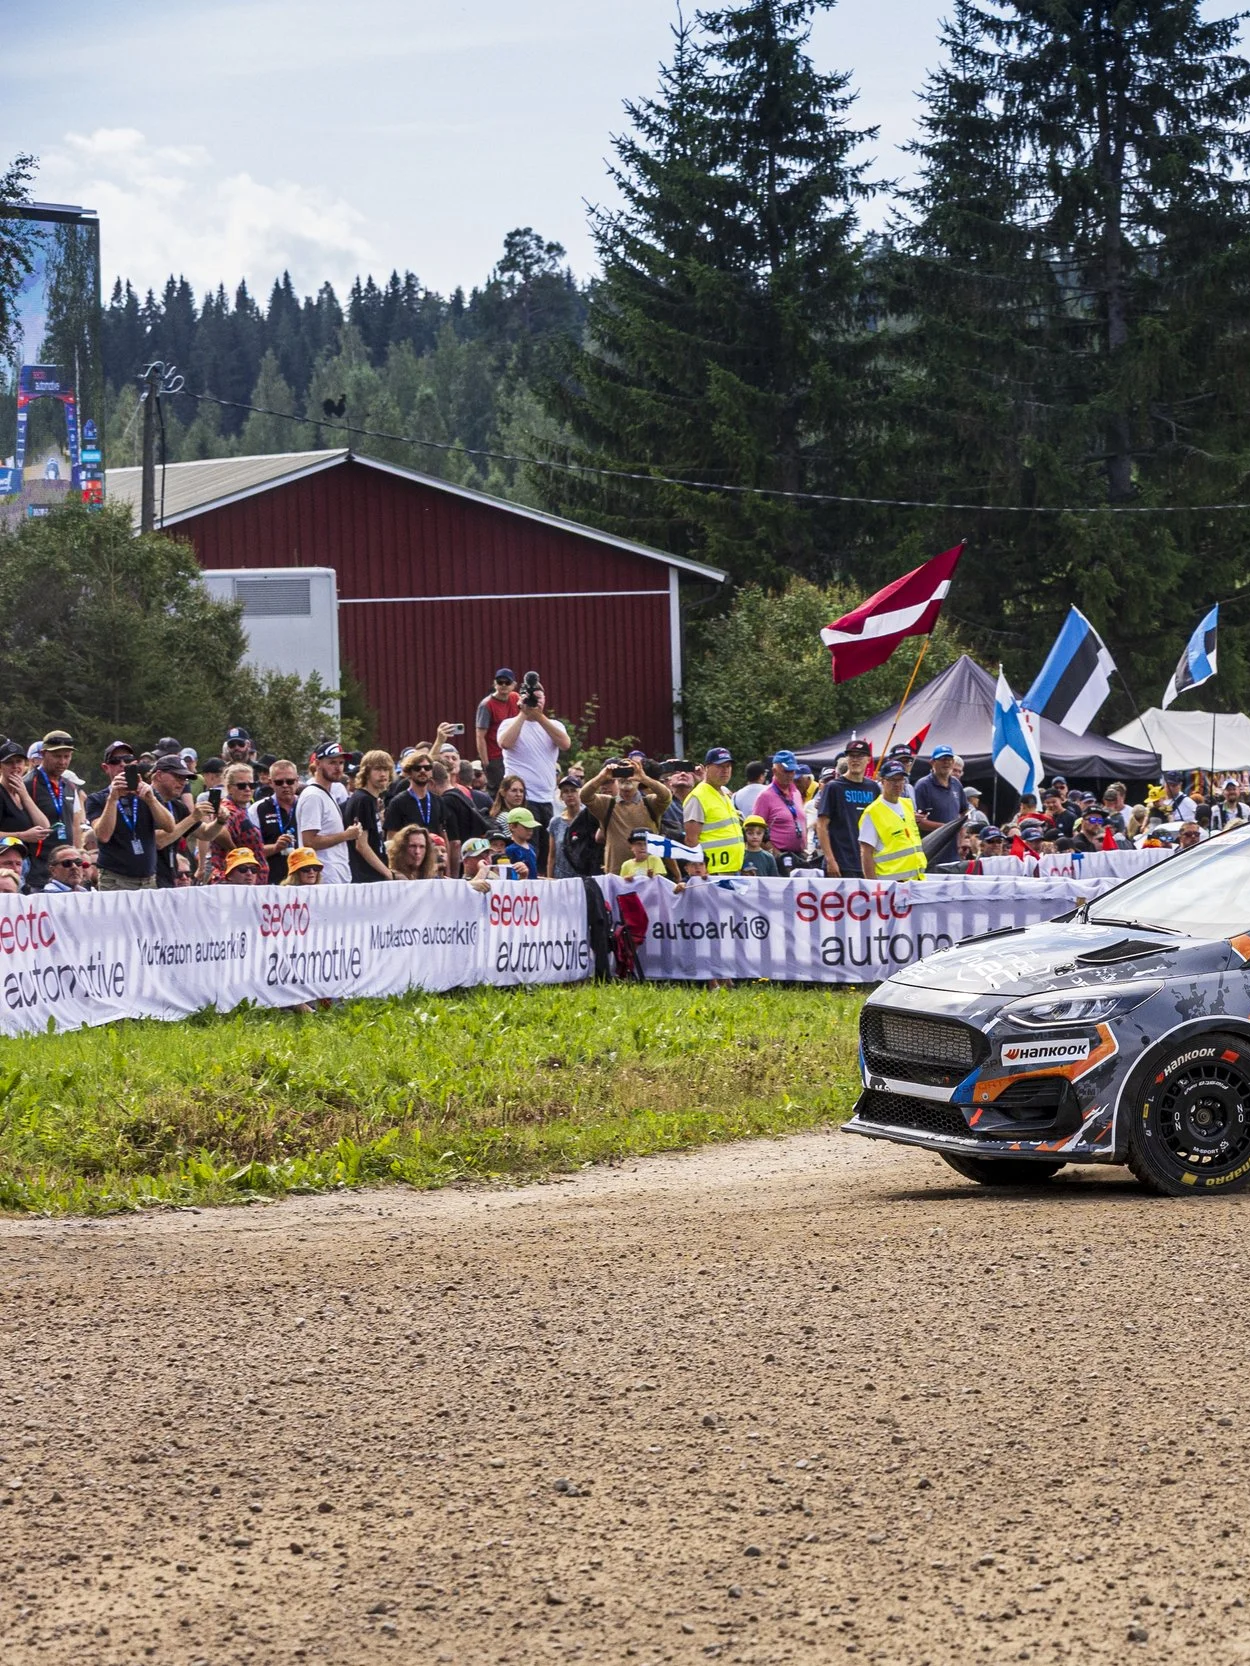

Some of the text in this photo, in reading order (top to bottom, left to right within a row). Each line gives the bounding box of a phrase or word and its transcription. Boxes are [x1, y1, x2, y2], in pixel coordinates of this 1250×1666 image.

[711, 851, 729, 866] 10
[260, 898, 310, 937] secto
[490, 889, 539, 927] secto
[796, 882, 912, 922] secto
[0, 904, 56, 955] ecto
[267, 941, 361, 986] automotive
